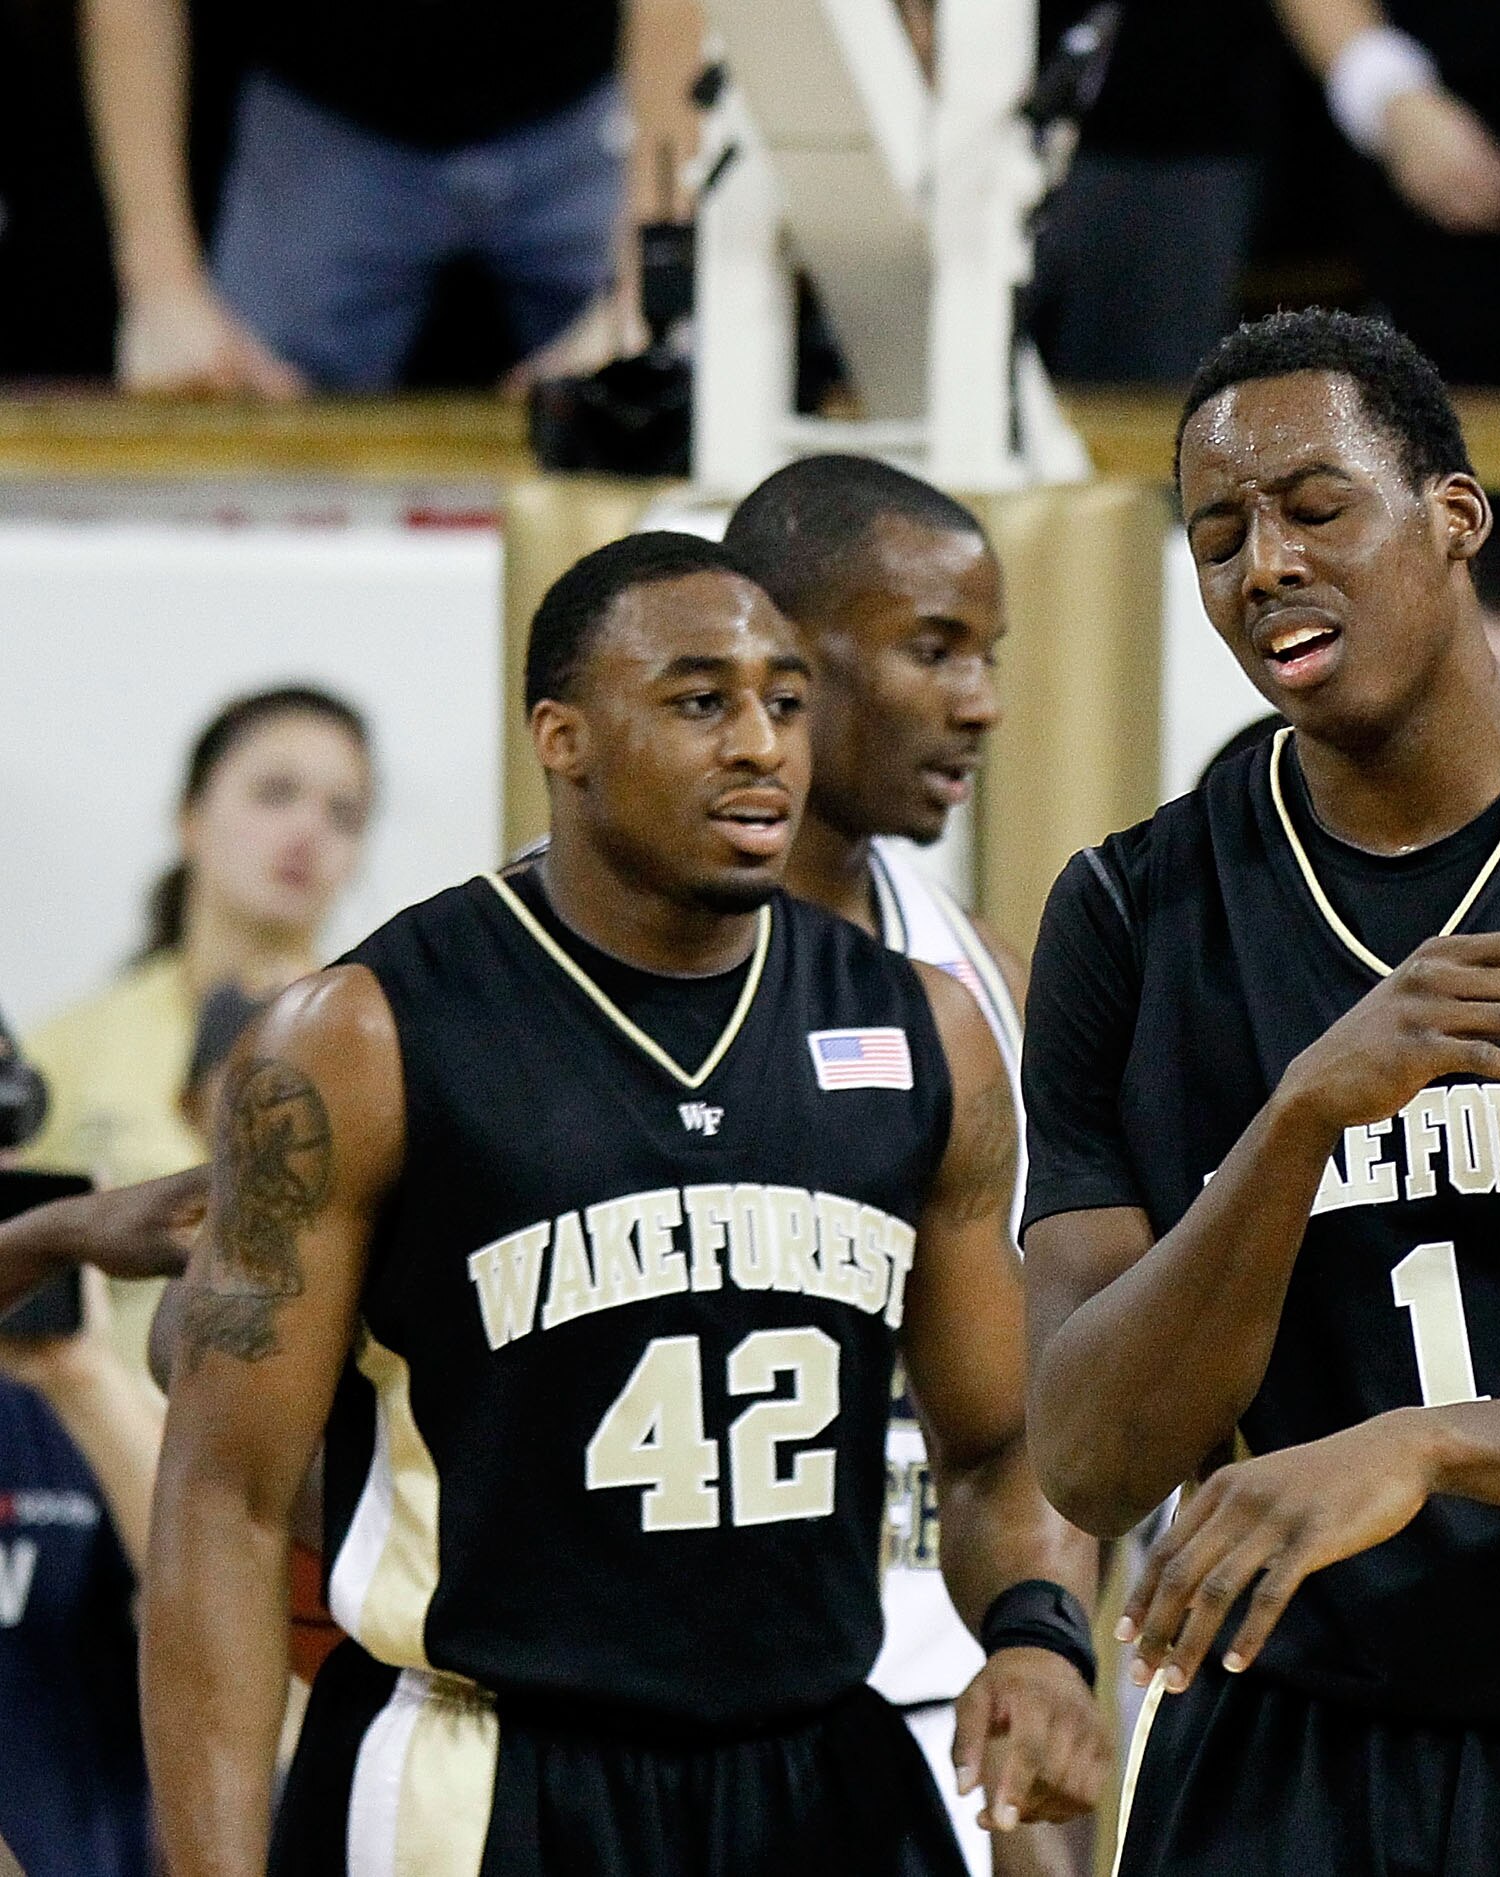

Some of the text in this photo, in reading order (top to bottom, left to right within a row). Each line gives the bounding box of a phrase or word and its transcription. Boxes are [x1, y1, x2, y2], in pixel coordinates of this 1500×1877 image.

[467, 1182, 917, 1351] WAKE FOREST
[1391, 1241, 1491, 1408] 1
[585, 1326, 841, 1533] 42
